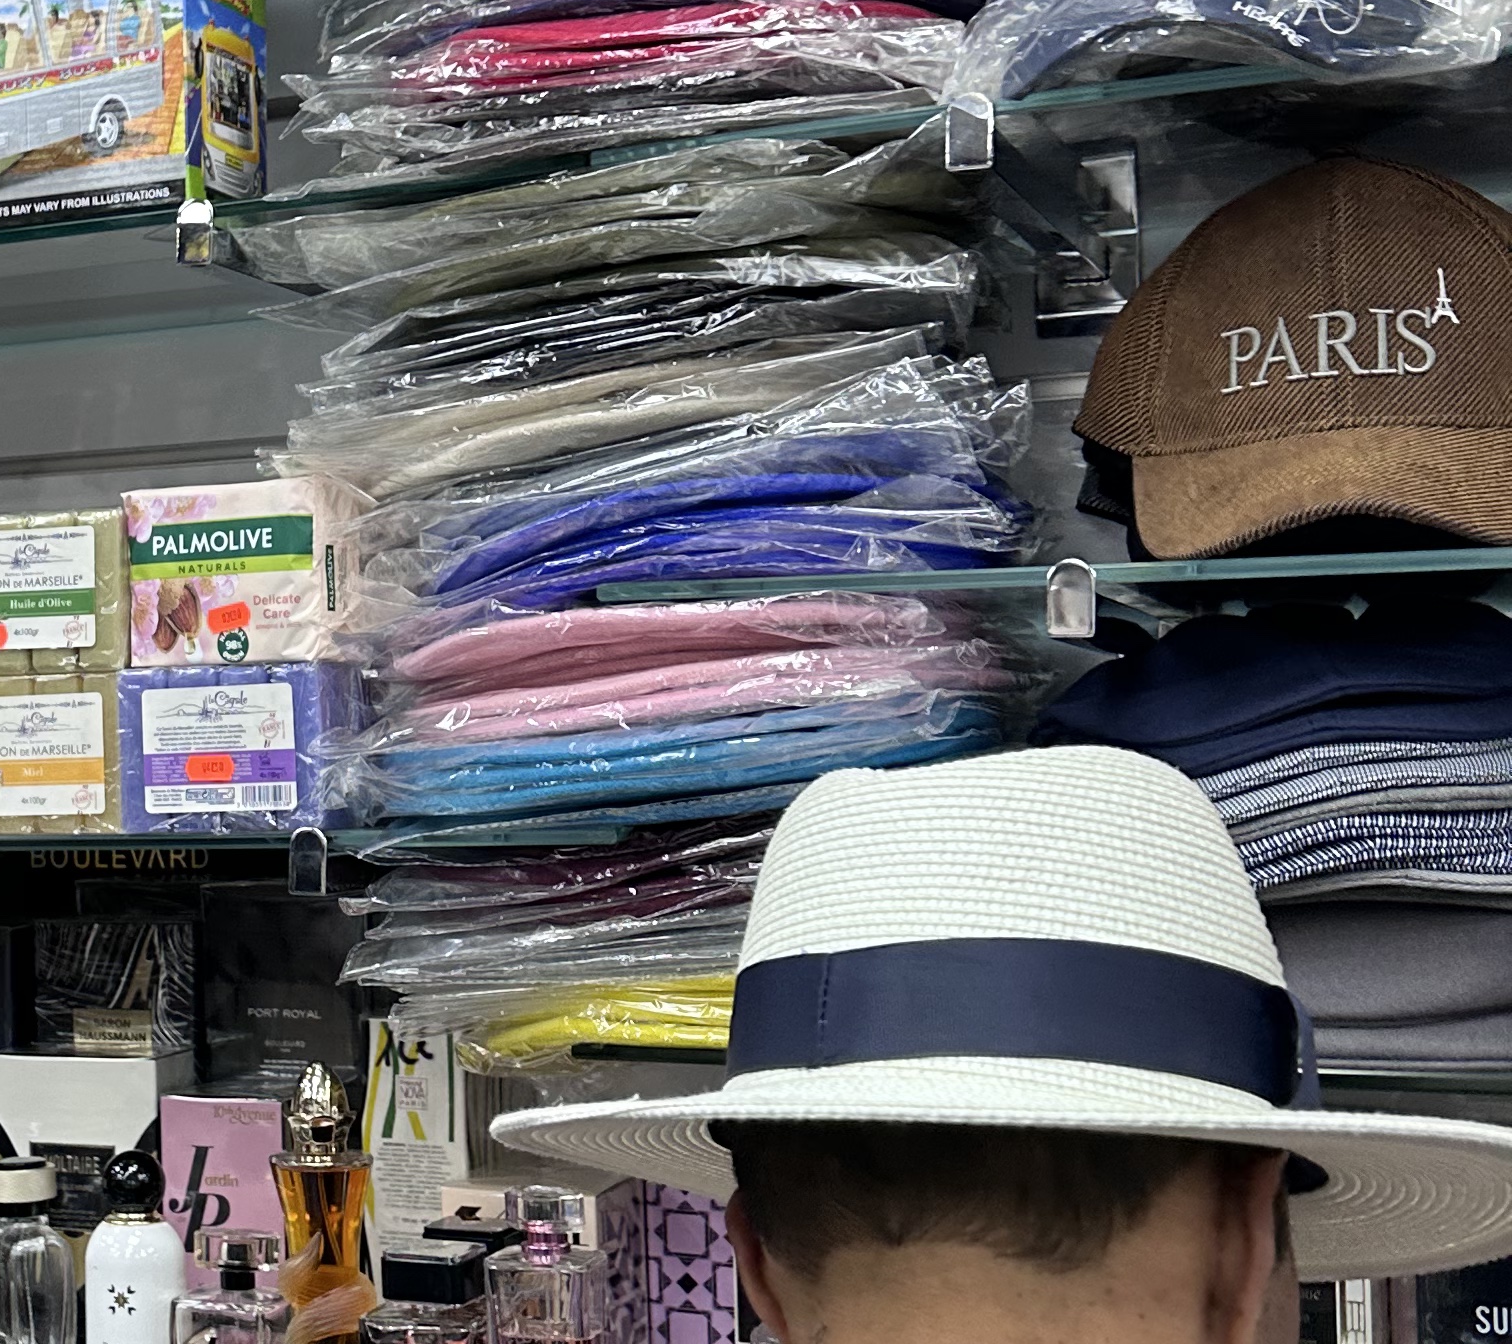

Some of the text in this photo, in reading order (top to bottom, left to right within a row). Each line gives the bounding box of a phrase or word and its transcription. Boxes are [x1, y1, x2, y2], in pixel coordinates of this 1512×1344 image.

[12, 203, 31, 217] MAY
[33, 200, 59, 214] VARY
[61, 197, 90, 210] FROM
[92, 187, 170, 207] ILLUSTRATIONS
[1220, 308, 1439, 394] PARIS
[151, 527, 273, 557] PALMOLIVE
[178, 560, 248, 576] NATURALS
[24, 575, 80, 588] MARSEILLE
[326, 547, 335, 610] PALMOLIVE
[10, 597, 73, 610] Huile d'Olive
[252, 593, 302, 606] Delicate
[262, 607, 291, 619] Care
[31, 743, 88, 756] MARSEILLE
[21, 766, 45, 778] Miel
[29, 847, 210, 869] BOULEVARD
[247, 1007, 322, 1020] PORT ROYAL
